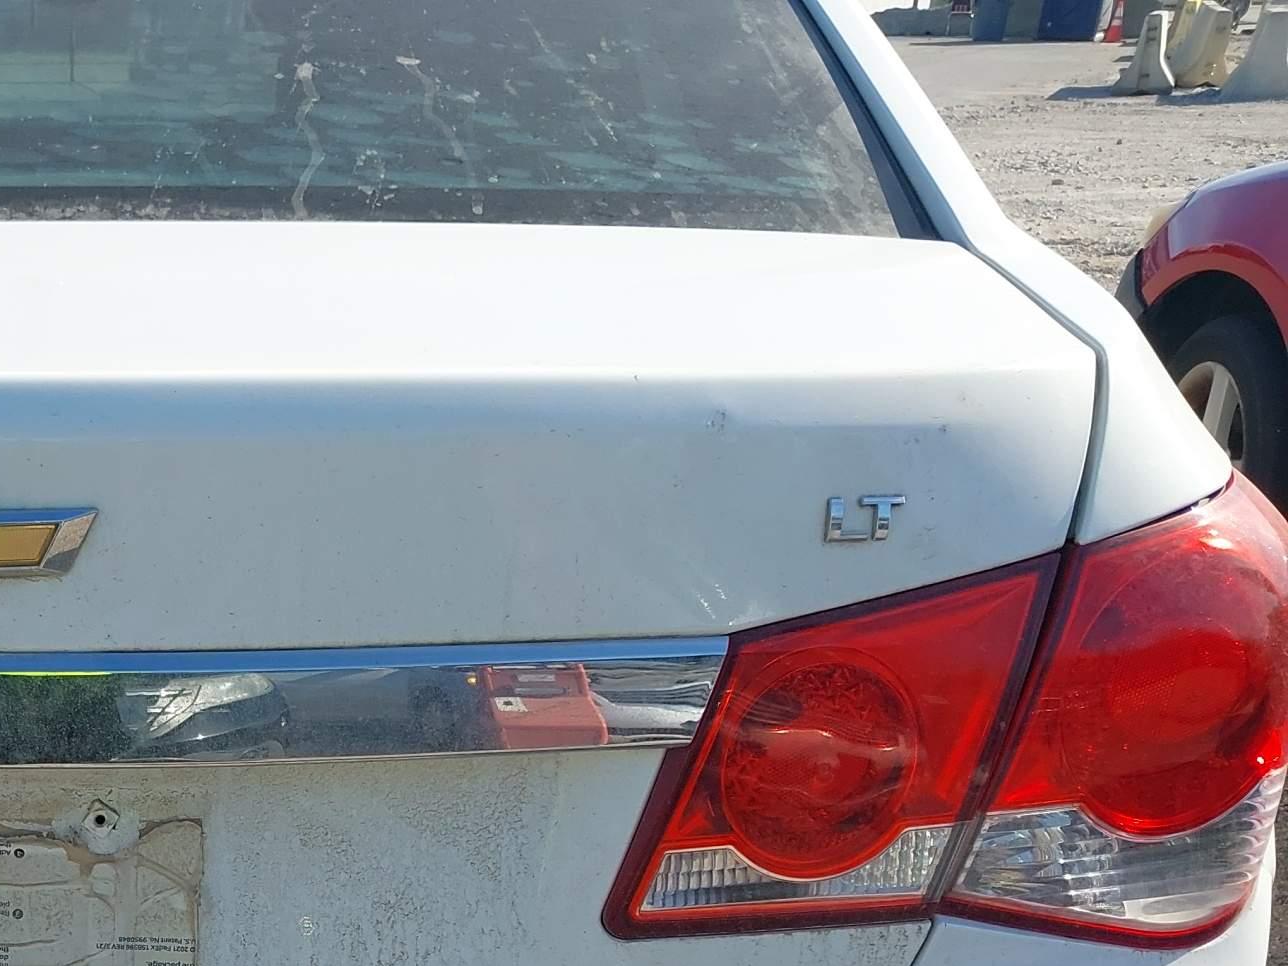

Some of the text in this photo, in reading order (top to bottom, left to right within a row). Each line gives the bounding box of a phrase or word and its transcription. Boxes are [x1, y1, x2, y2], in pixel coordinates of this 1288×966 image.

[824, 495, 906, 543] LT
[149, 936, 160, 944] No.
[150, 944, 172, 952] FedEx
